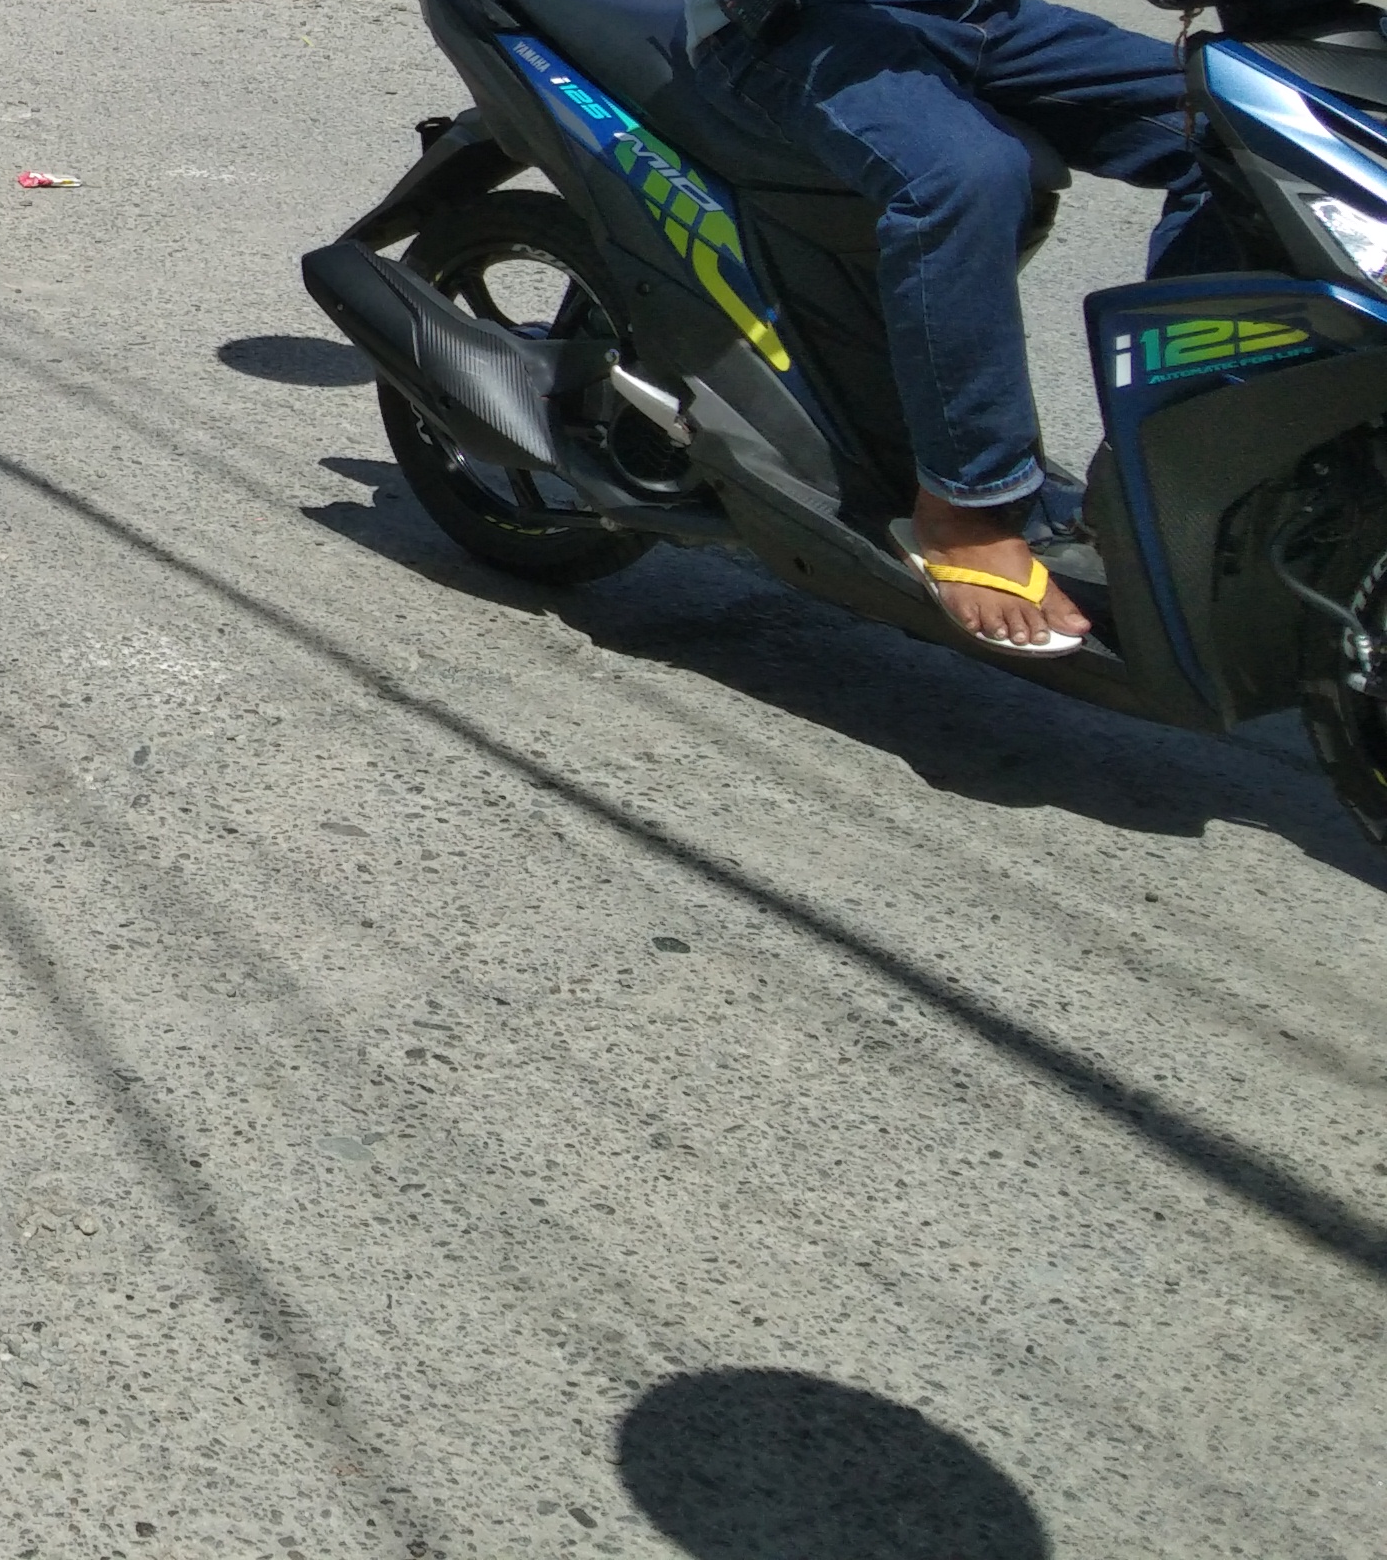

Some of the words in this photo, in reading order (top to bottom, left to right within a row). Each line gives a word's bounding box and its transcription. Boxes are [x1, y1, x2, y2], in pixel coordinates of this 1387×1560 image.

[511, 40, 552, 74] YAMAHA
[1147, 358, 1240, 386] AUTOMATIC
[1239, 353, 1274, 368] FOR
[1276, 345, 1317, 360] LIFE
